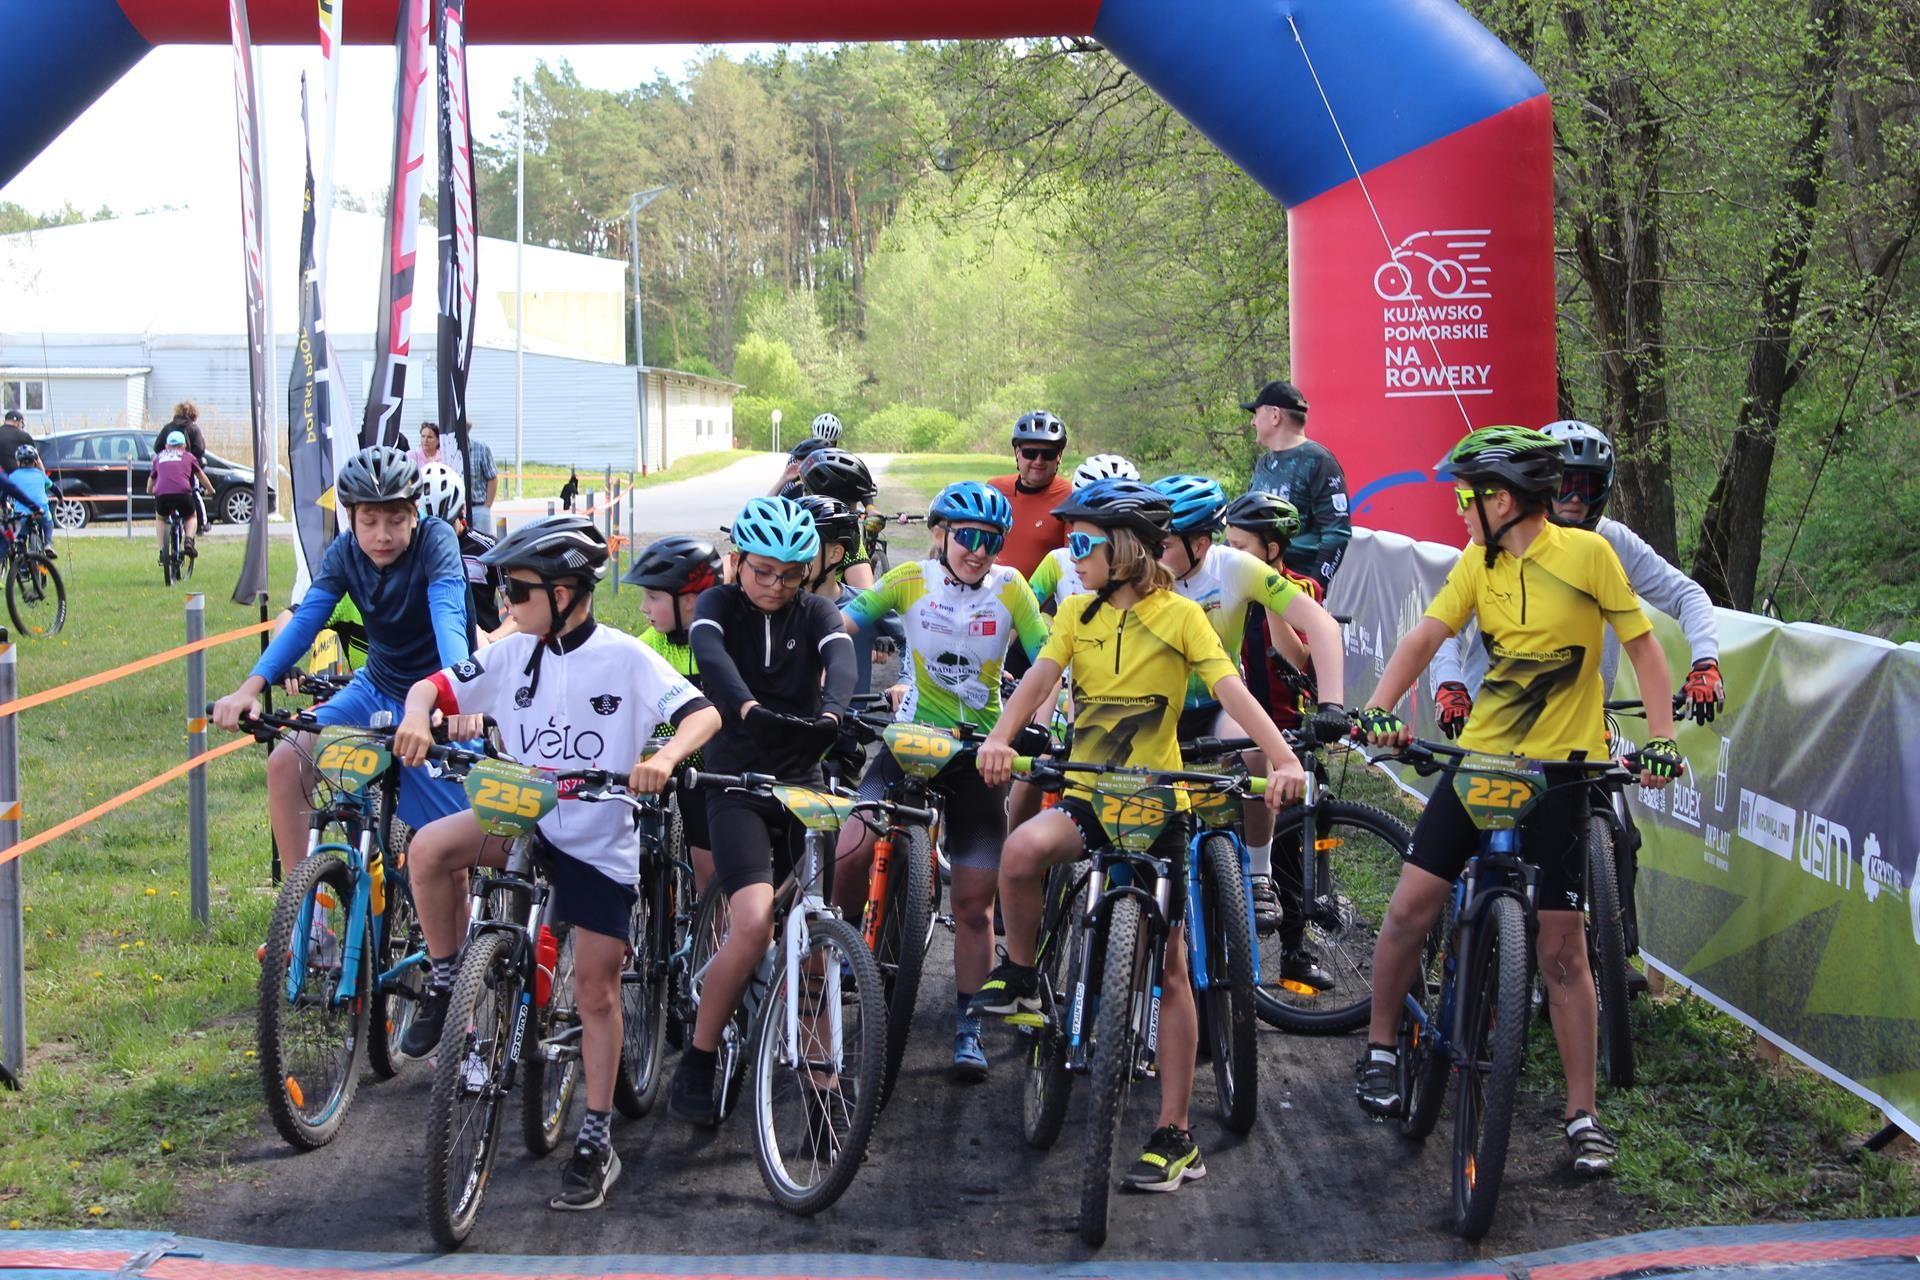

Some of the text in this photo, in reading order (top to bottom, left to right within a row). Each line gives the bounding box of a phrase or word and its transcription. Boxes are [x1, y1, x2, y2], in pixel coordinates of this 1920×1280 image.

[1384, 305, 1482, 323] KUJAWSKO
[1384, 324, 1488, 342] POMORSKIE
[1385, 346, 1421, 366] NA
[1385, 365, 1492, 388] ROWERY
[893, 732, 951, 758] 230
[318, 744, 379, 775] 220
[474, 778, 542, 818] 235
[1467, 776, 1532, 809] 227
[1673, 782, 1701, 820] BUDEX
[1102, 794, 1165, 826] 228
